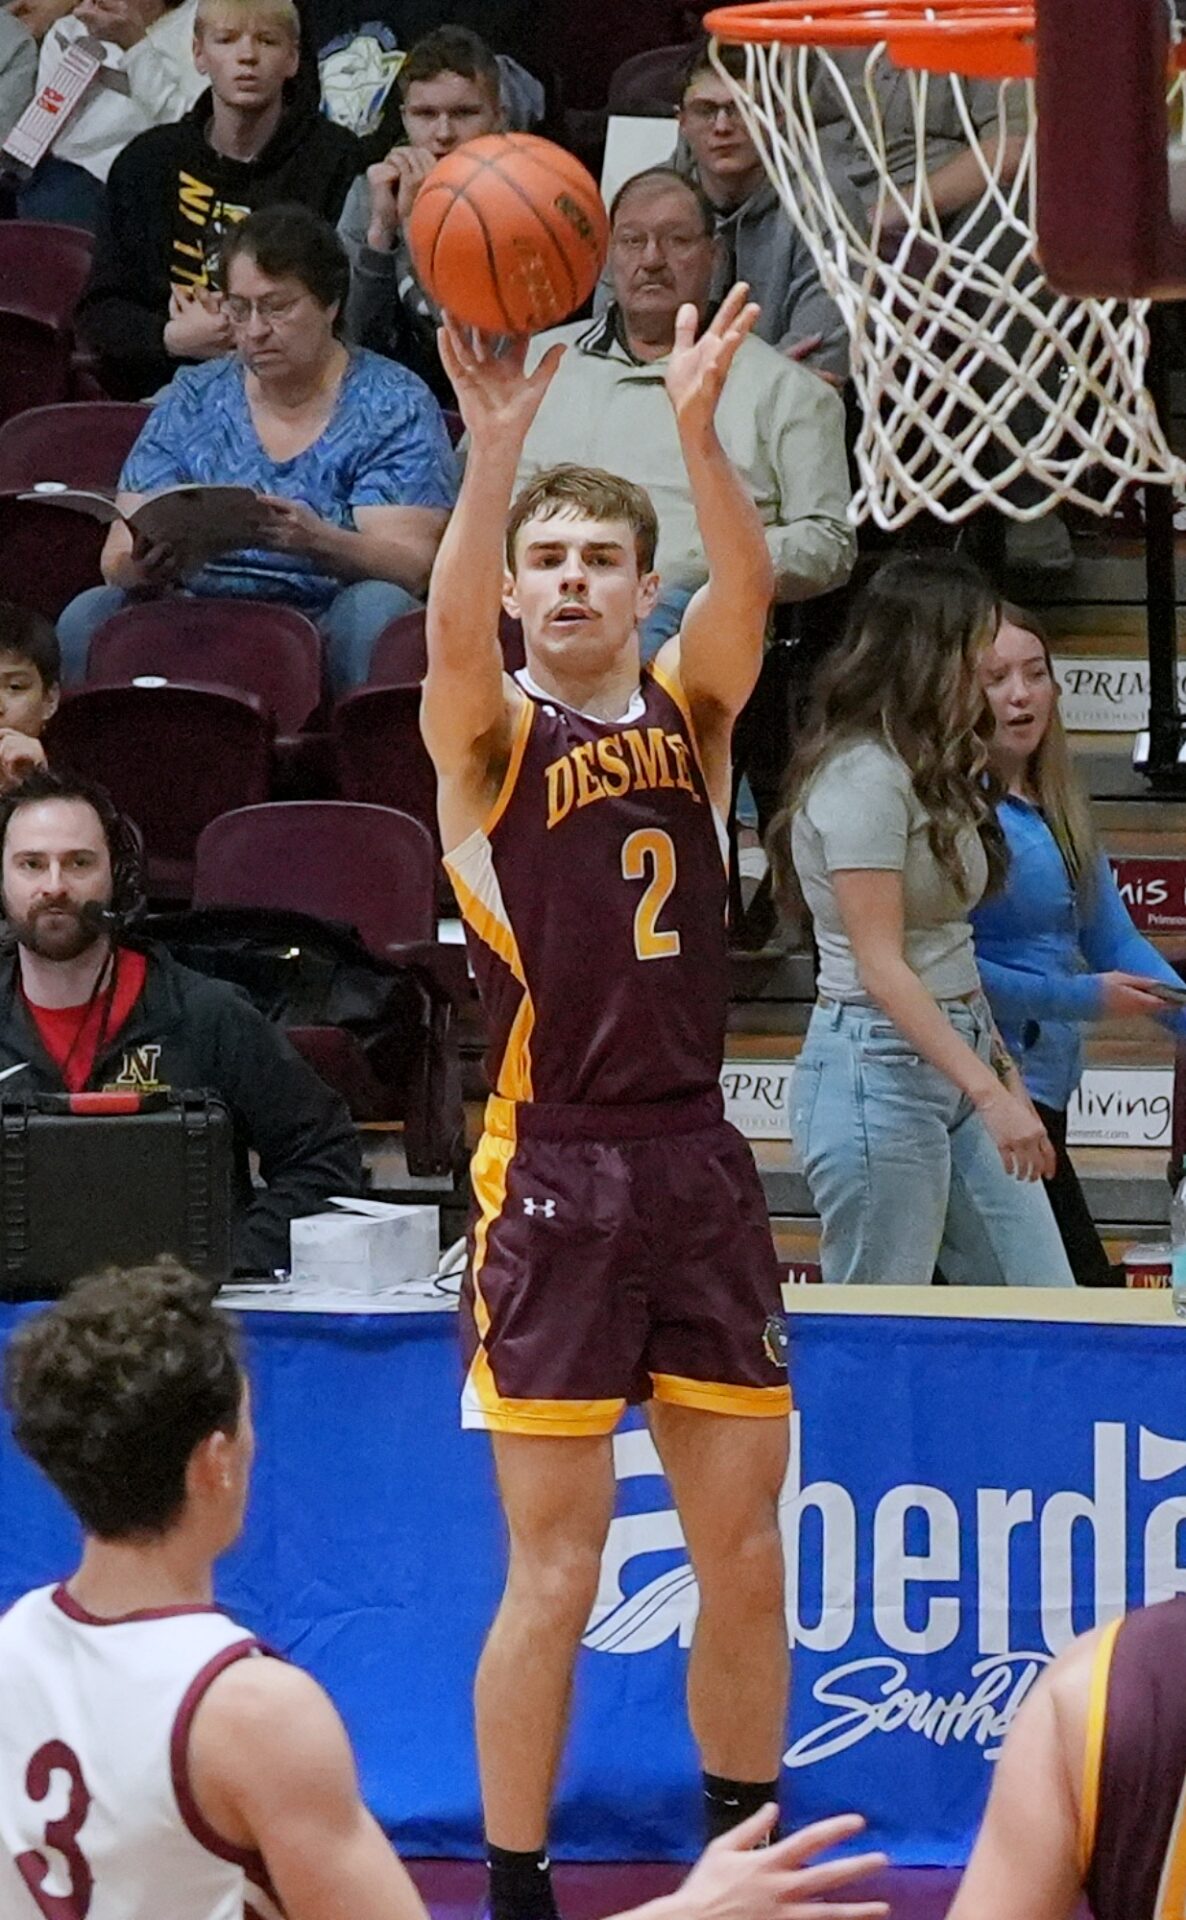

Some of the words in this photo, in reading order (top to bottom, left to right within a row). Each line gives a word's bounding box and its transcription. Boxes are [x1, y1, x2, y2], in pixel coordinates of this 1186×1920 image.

[544, 727, 701, 830] DESME
[620, 827, 681, 961] 2
[116, 1044, 161, 1085] N
[1078, 1086, 1170, 1140] living
[14, 1738, 95, 1920] 3
